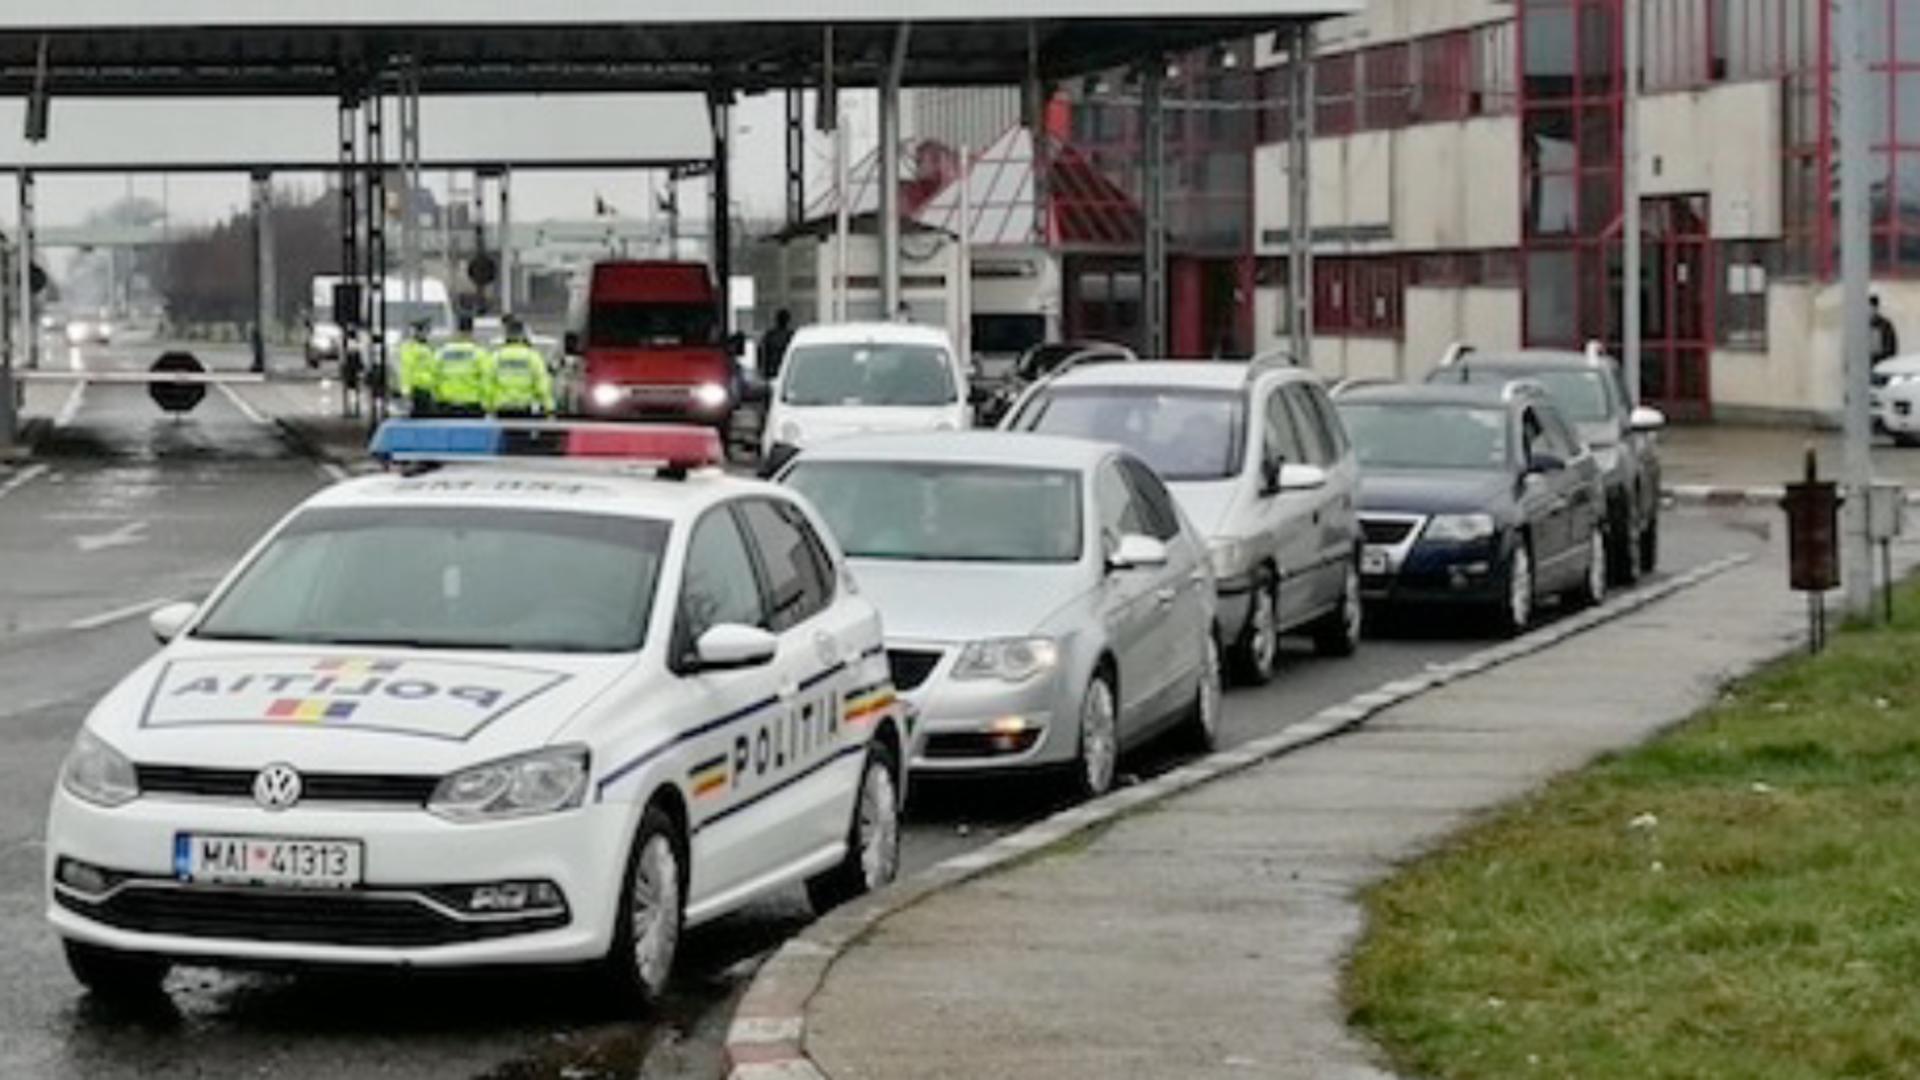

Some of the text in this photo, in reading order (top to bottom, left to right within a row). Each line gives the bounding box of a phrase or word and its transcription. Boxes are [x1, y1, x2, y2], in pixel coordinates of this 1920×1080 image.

[732, 690, 838, 788] POLITIA
[203, 842, 348, 875] MAI 41313
